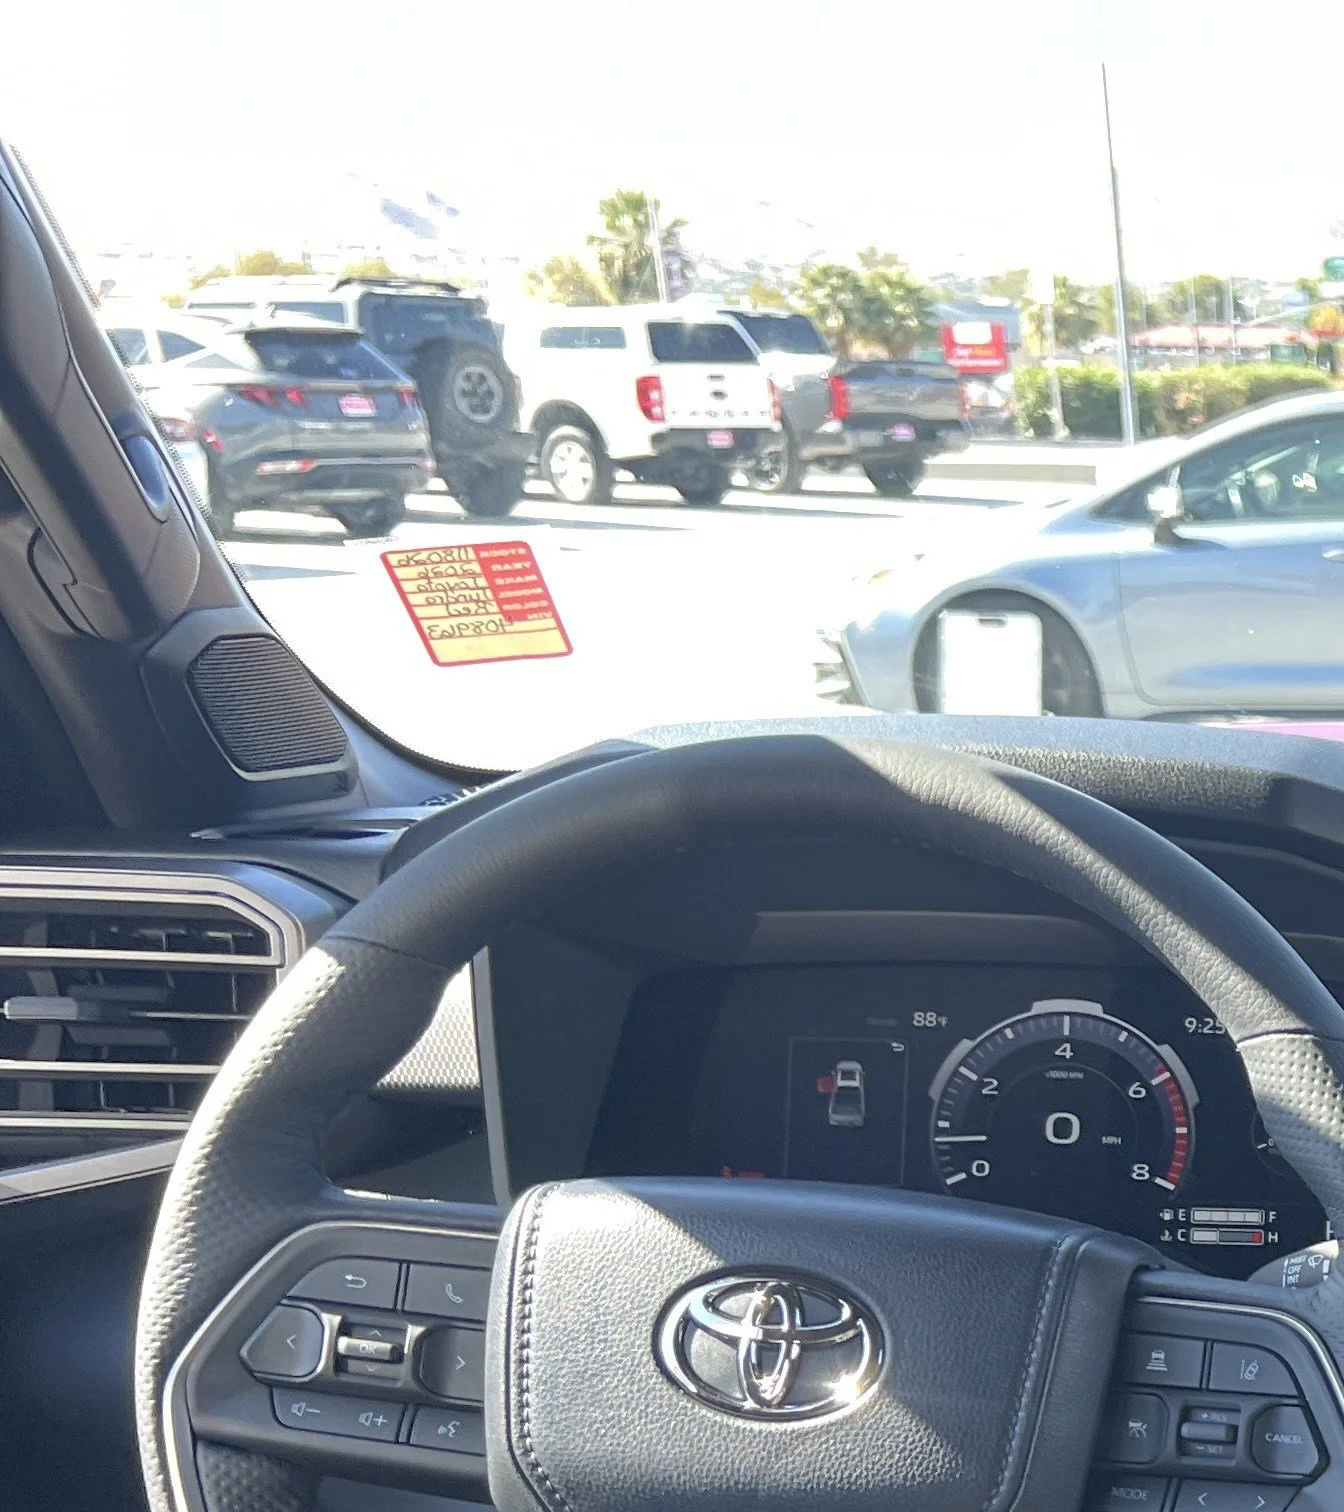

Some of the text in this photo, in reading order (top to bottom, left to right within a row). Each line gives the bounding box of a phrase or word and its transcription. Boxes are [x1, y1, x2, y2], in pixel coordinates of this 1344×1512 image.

[1184, 1017, 1226, 1035] 9:25
[1054, 1042, 1074, 1059] 4
[981, 1077, 999, 1095] 2
[1128, 1082, 1147, 1099] 6
[1045, 1111, 1081, 1145] 0
[971, 1159, 990, 1177] 0
[1131, 1163, 1150, 1181] 8
[1178, 1209, 1187, 1222] E
[1268, 1211, 1278, 1223] F
[1177, 1228, 1186, 1242] C
[1268, 1232, 1279, 1243] H
[1265, 1432, 1304, 1445] CANCEL
[1111, 1486, 1149, 1501] MODE
